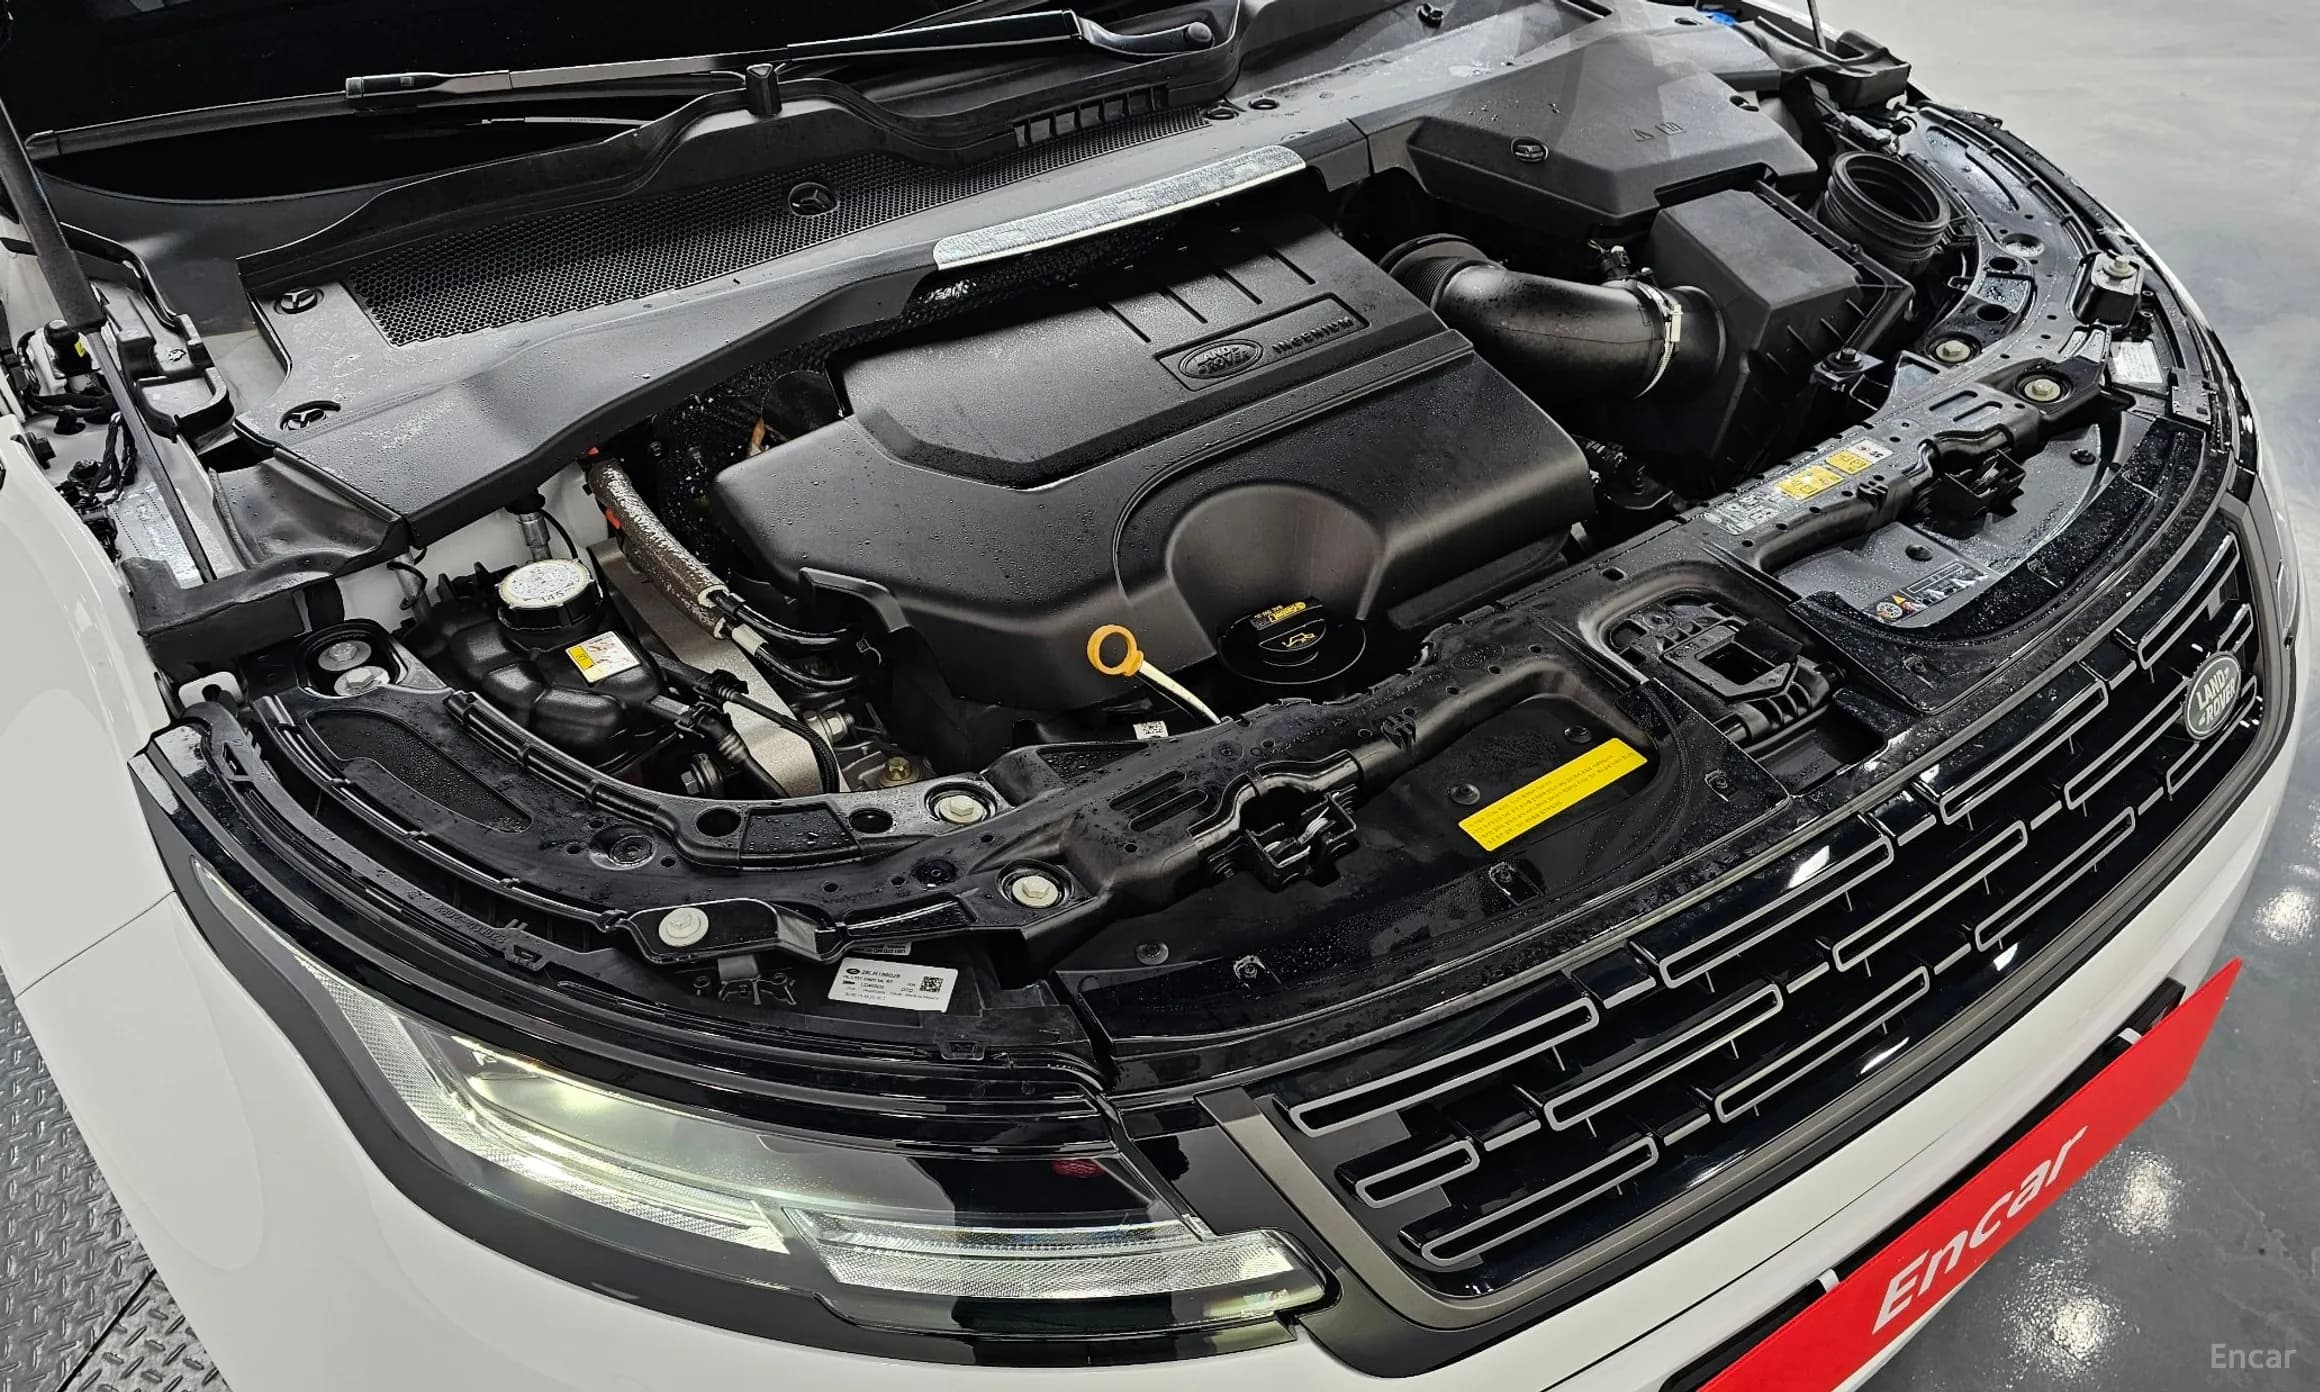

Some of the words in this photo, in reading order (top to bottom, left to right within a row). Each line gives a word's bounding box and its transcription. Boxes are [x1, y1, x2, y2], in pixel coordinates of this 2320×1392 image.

[1196, 344, 1231, 366] LAND
[1271, 314, 1354, 355] INGENIUM
[2196, 669, 2226, 711] LAND
[2206, 678, 2236, 725] ROVER
[1872, 1125, 2088, 1335] Encar
